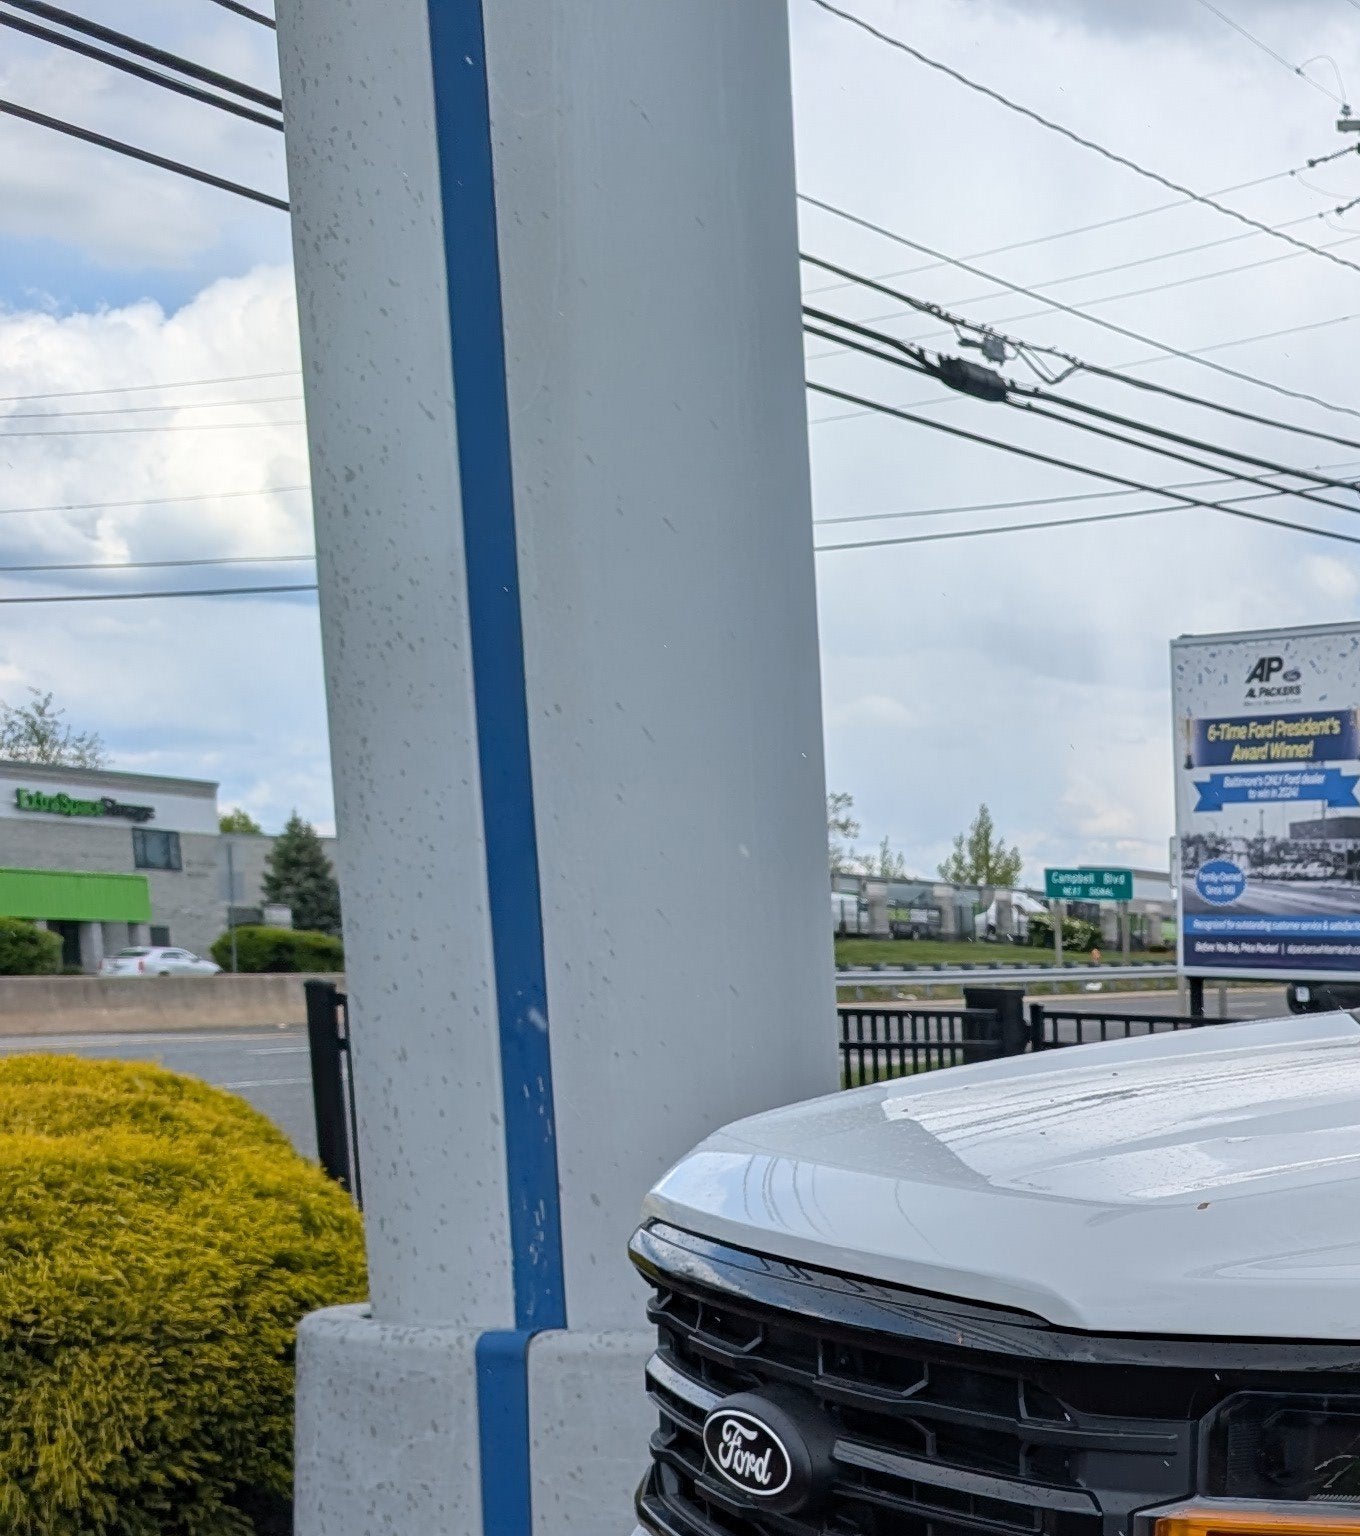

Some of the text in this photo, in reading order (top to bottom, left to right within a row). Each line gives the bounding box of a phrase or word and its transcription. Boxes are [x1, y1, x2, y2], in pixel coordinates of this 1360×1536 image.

[1245, 656, 1283, 683] AP
[1245, 684, 1302, 698] AL PACKERS
[1248, 720, 1275, 739] Ford
[1231, 742, 1269, 761] Award
[1051, 871, 1126, 886] Campbell Blvd
[718, 1419, 772, 1485] Ford
